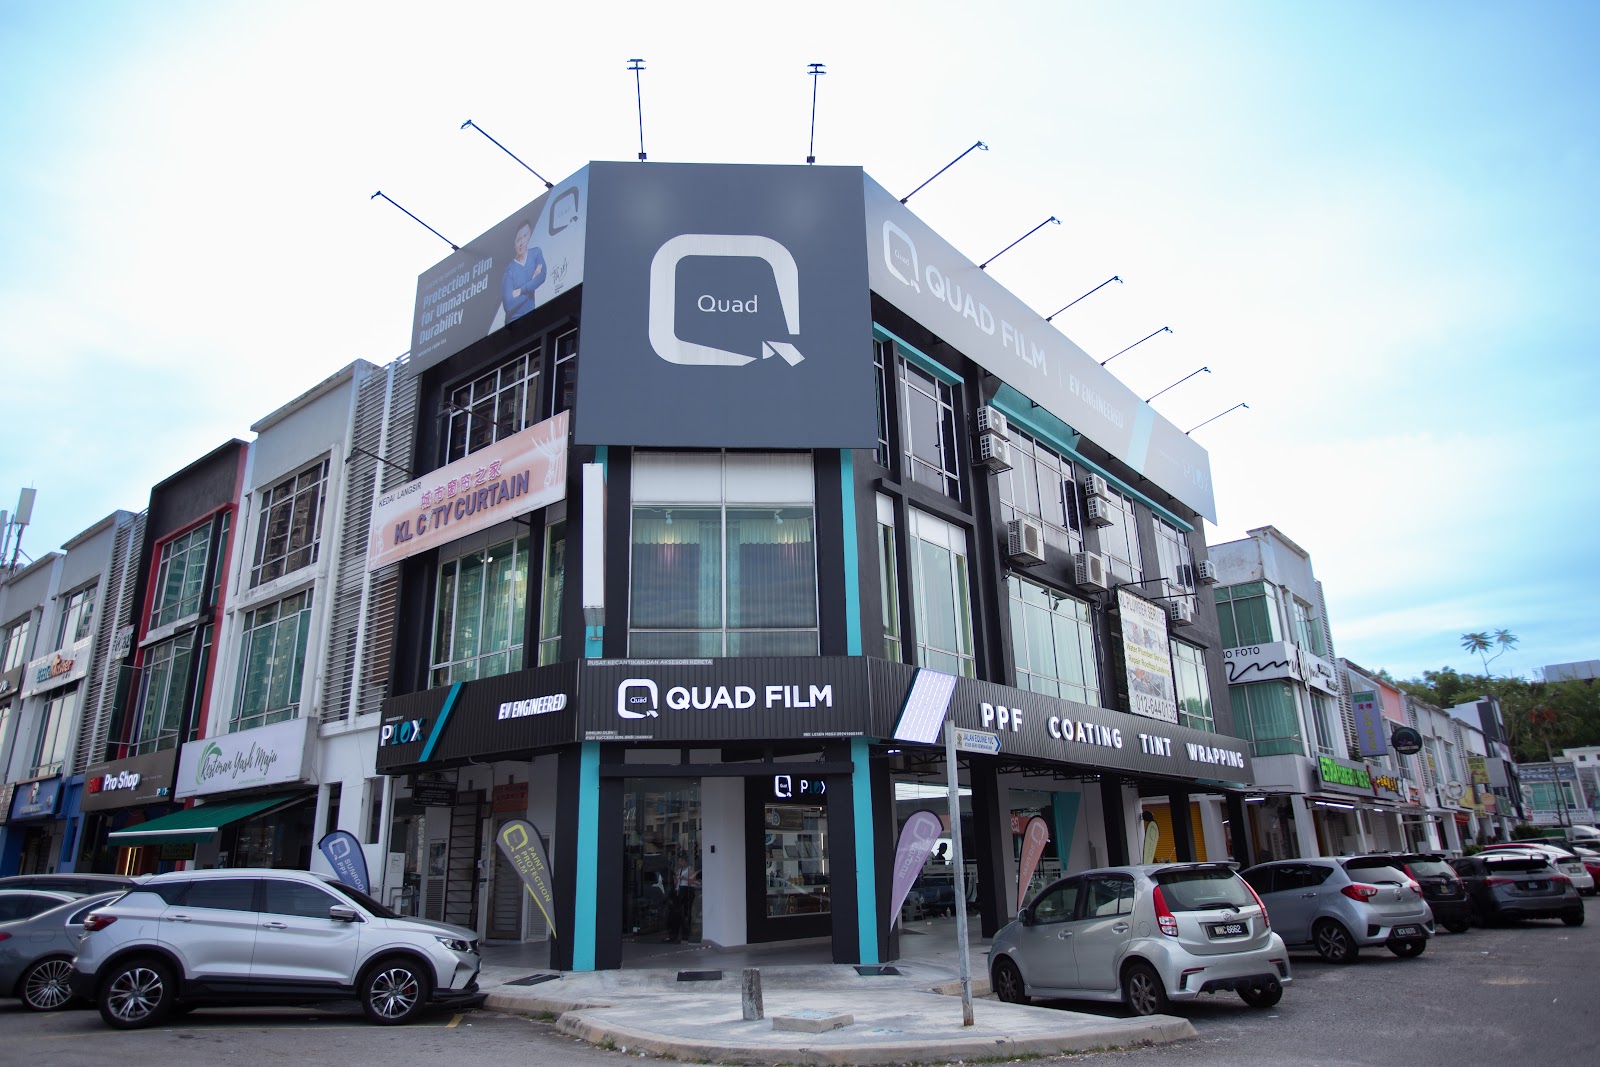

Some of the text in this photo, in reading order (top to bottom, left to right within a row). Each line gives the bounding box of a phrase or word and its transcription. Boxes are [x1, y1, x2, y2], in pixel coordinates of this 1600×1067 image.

[423, 271, 470, 309] Protection
[472, 257, 493, 279] Film
[421, 309, 434, 327] for
[436, 274, 489, 317] Unmatched
[697, 294, 758, 313] Quad
[419, 309, 464, 345] Durability
[925, 264, 1047, 377] QUAD FILM
[1069, 373, 1124, 429] EV ENGINEERED
[378, 481, 422, 508] KEDAI LANGSIR
[393, 520, 413, 546] KL
[454, 469, 530, 521] CURTAIN
[1235, 646, 1260, 657] FOTO
[498, 693, 567, 720] EV ENGINEERED
[630, 696, 647, 704] Quad
[666, 684, 833, 711] QUAD FILM
[980, 702, 1022, 732] PPF
[380, 717, 424, 747] P10X
[963, 733, 974, 741] JALAN
[974, 734, 987, 743] EQUINE
[1047, 716, 1123, 749] COATING
[1138, 733, 1172, 757] TINT
[232, 741, 256, 779] Yash
[254, 747, 278, 775] Maju
[1185, 741, 1245, 769] WRAPPING
[103, 773, 118, 791] Pro
[118, 770, 141, 791] Shop
[337, 861, 348, 877] PPF
[514, 854, 528, 875] FILM
[528, 846, 545, 871] PAINT
[520, 850, 551, 902] PROTECTION
